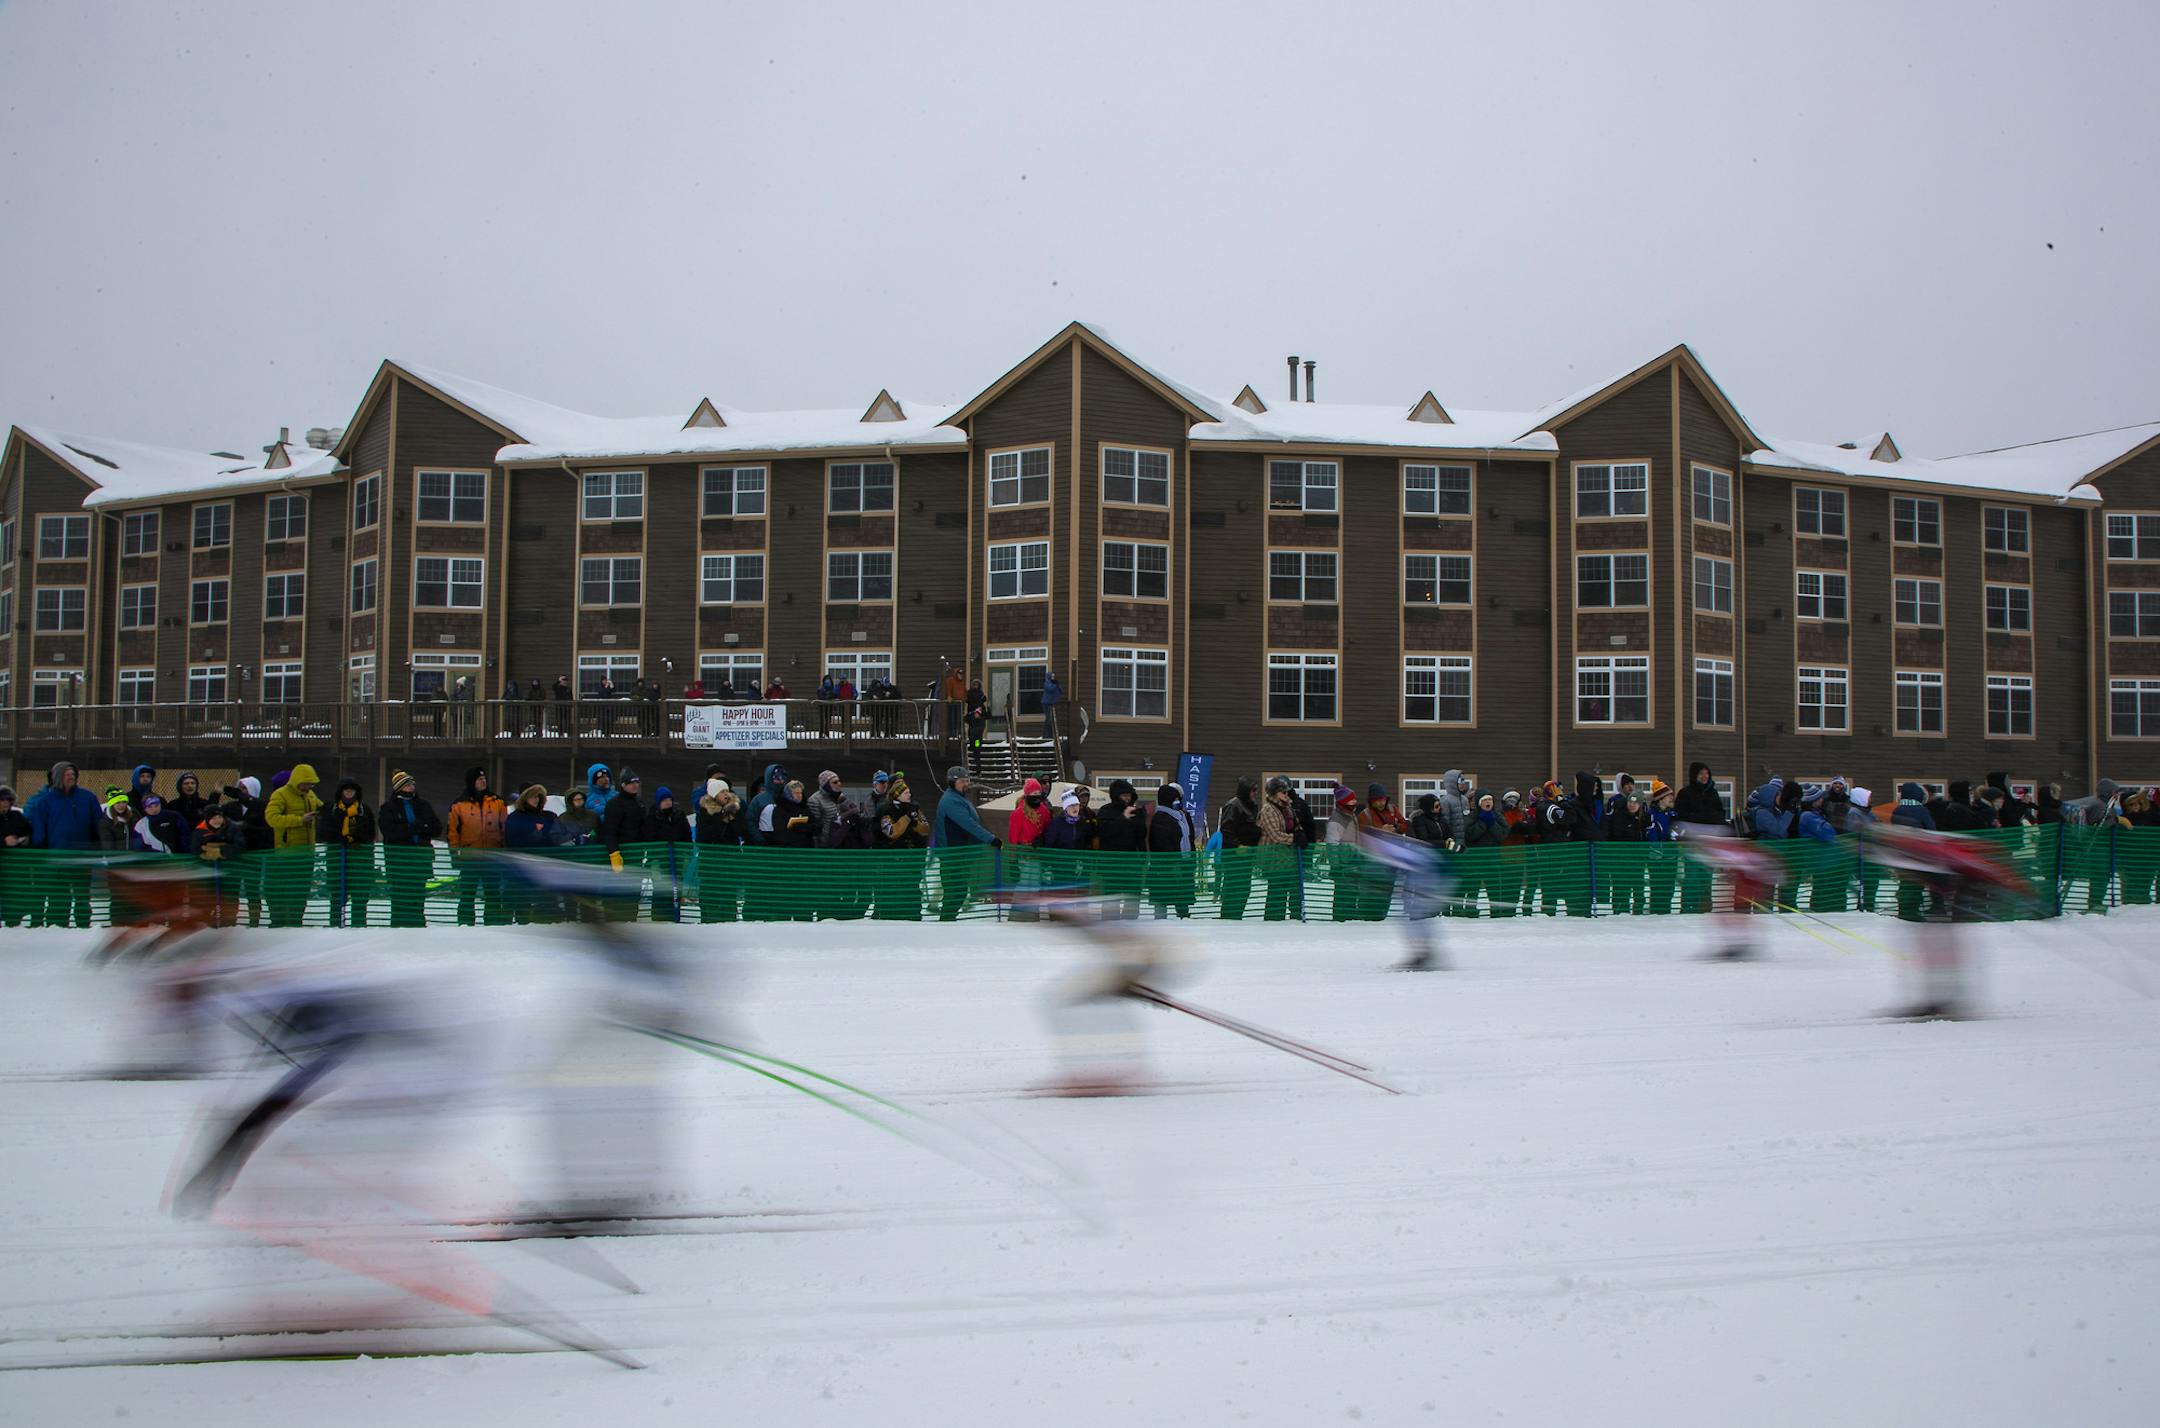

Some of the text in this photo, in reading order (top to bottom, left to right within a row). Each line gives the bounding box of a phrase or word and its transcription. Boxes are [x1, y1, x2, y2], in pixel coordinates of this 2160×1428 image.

[722, 708, 774, 719] HAPPY HOUR
[692, 725, 710, 733] GIANT
[715, 731, 750, 740] APPETIZER
[752, 731, 784, 740] SPECIALS
